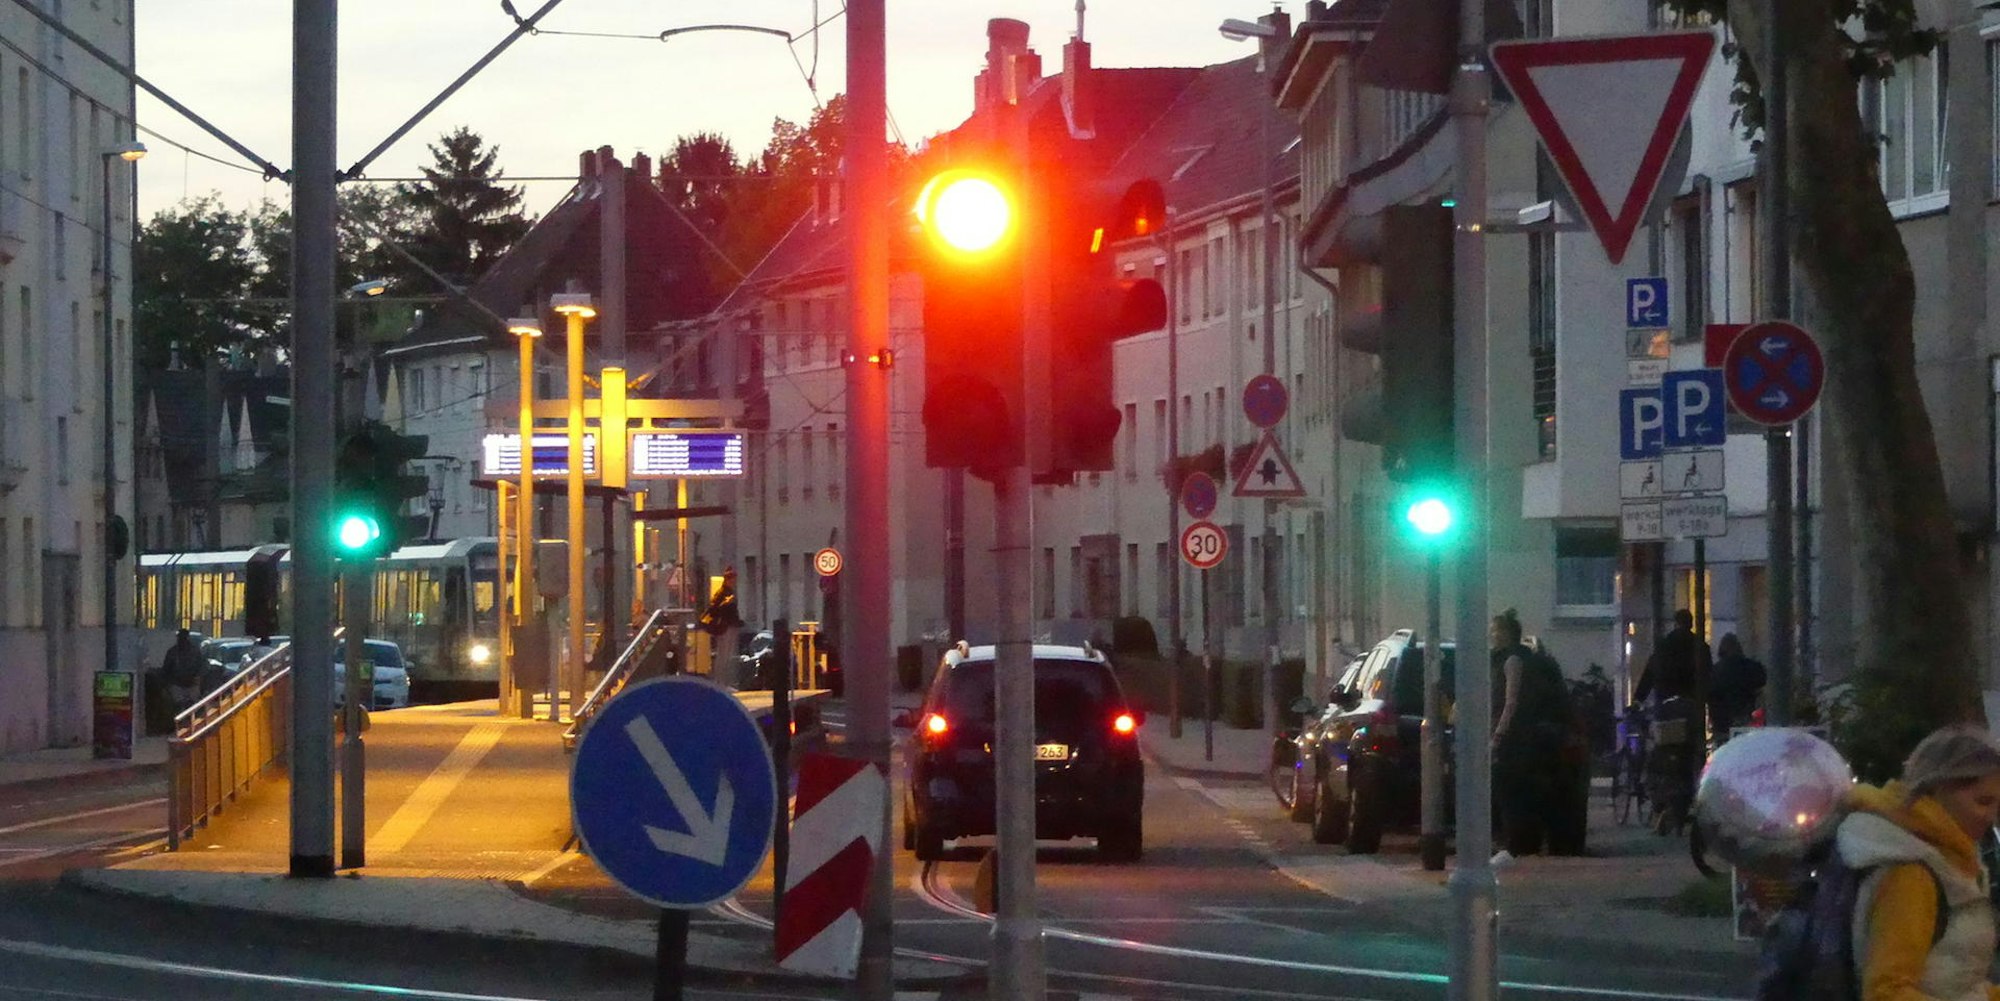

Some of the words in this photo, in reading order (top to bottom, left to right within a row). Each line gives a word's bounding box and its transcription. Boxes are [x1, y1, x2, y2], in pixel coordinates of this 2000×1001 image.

[1633, 284, 1655, 322] P
[1633, 397, 1663, 451] P
[1675, 380, 1710, 438] P
[1191, 534, 1217, 556] 30
[821, 555, 836, 569] 50
[1040, 746, 1064, 758] 263
